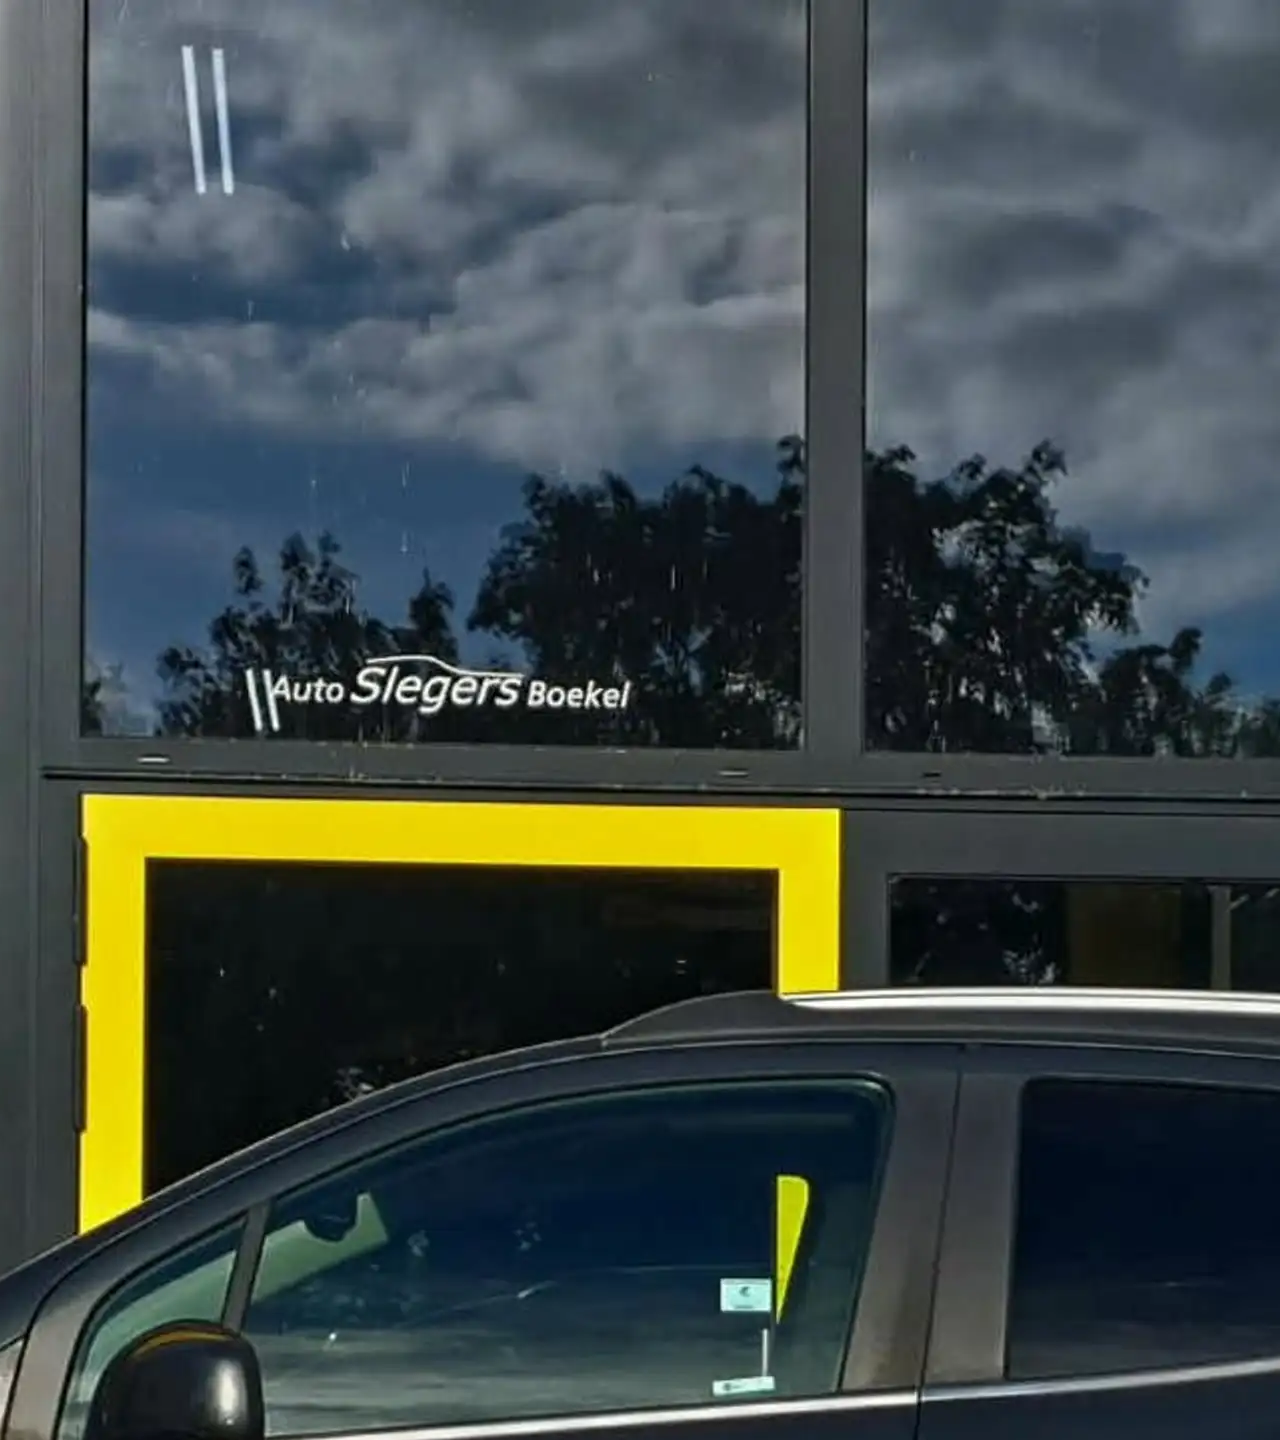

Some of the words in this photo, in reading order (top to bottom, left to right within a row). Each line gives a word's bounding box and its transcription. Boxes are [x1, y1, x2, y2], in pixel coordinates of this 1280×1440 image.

[273, 674, 344, 703] Auto
[350, 665, 522, 714] Slegers
[527, 680, 631, 708] Boekel
